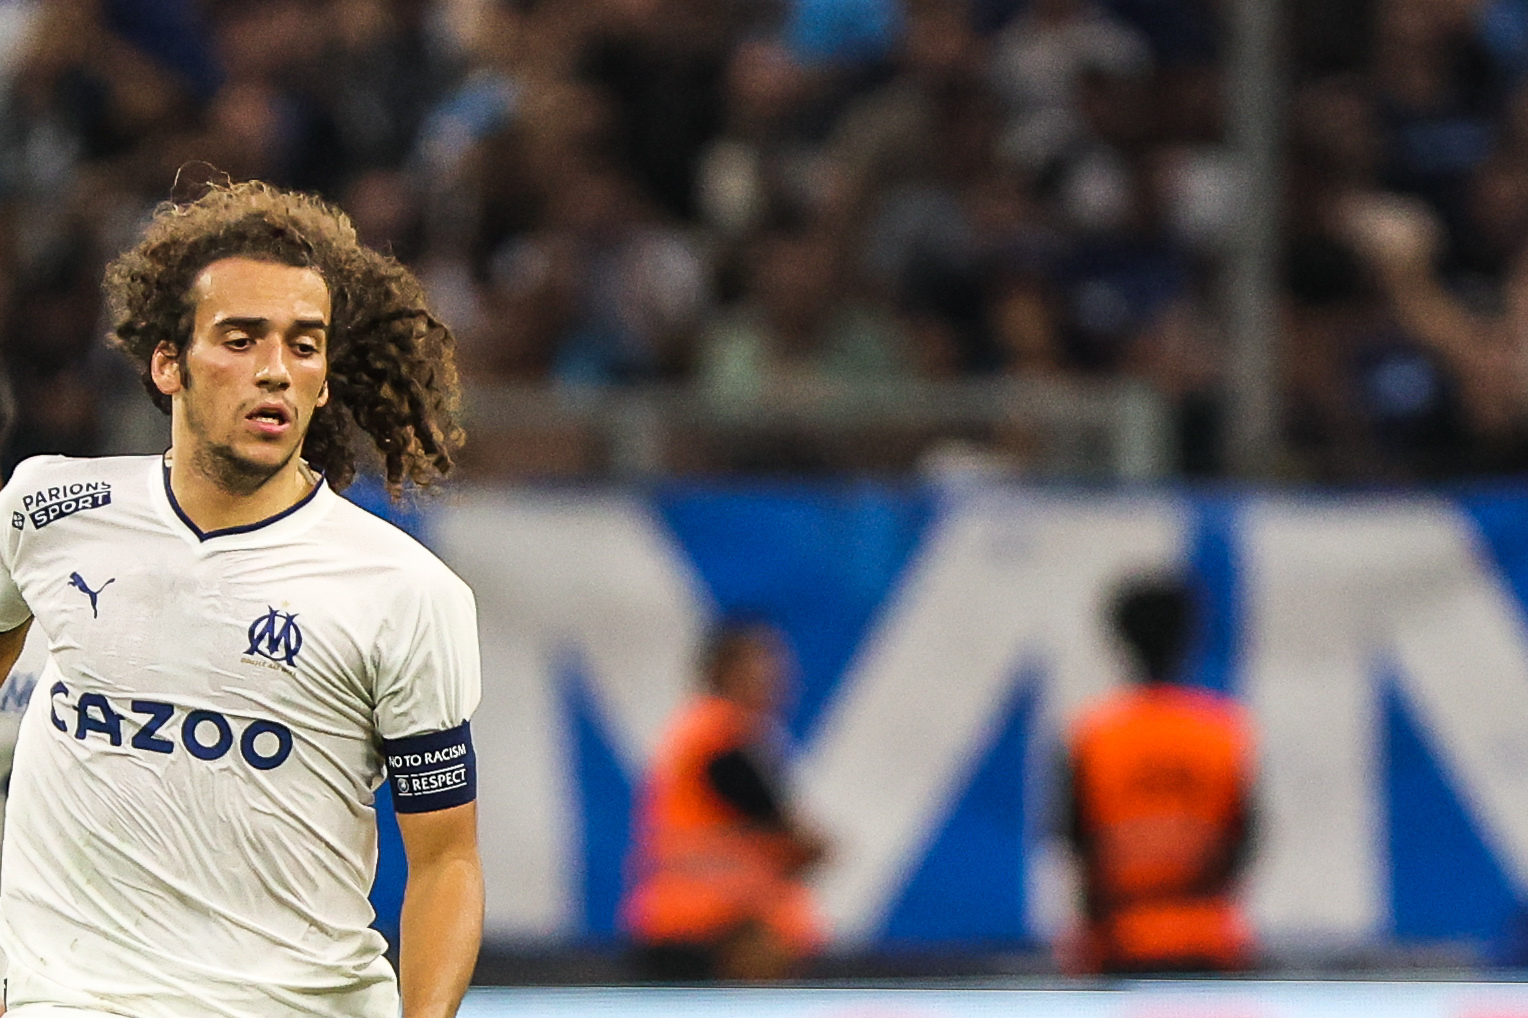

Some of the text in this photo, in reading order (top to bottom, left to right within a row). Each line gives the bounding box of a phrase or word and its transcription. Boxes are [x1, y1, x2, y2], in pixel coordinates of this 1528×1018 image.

[23, 481, 111, 511] PARIONS
[32, 491, 110, 528] SPORT
[50, 680, 294, 771] CAZOO
[388, 743, 467, 768] NO TO RACISM
[412, 768, 467, 791] RESPECT
